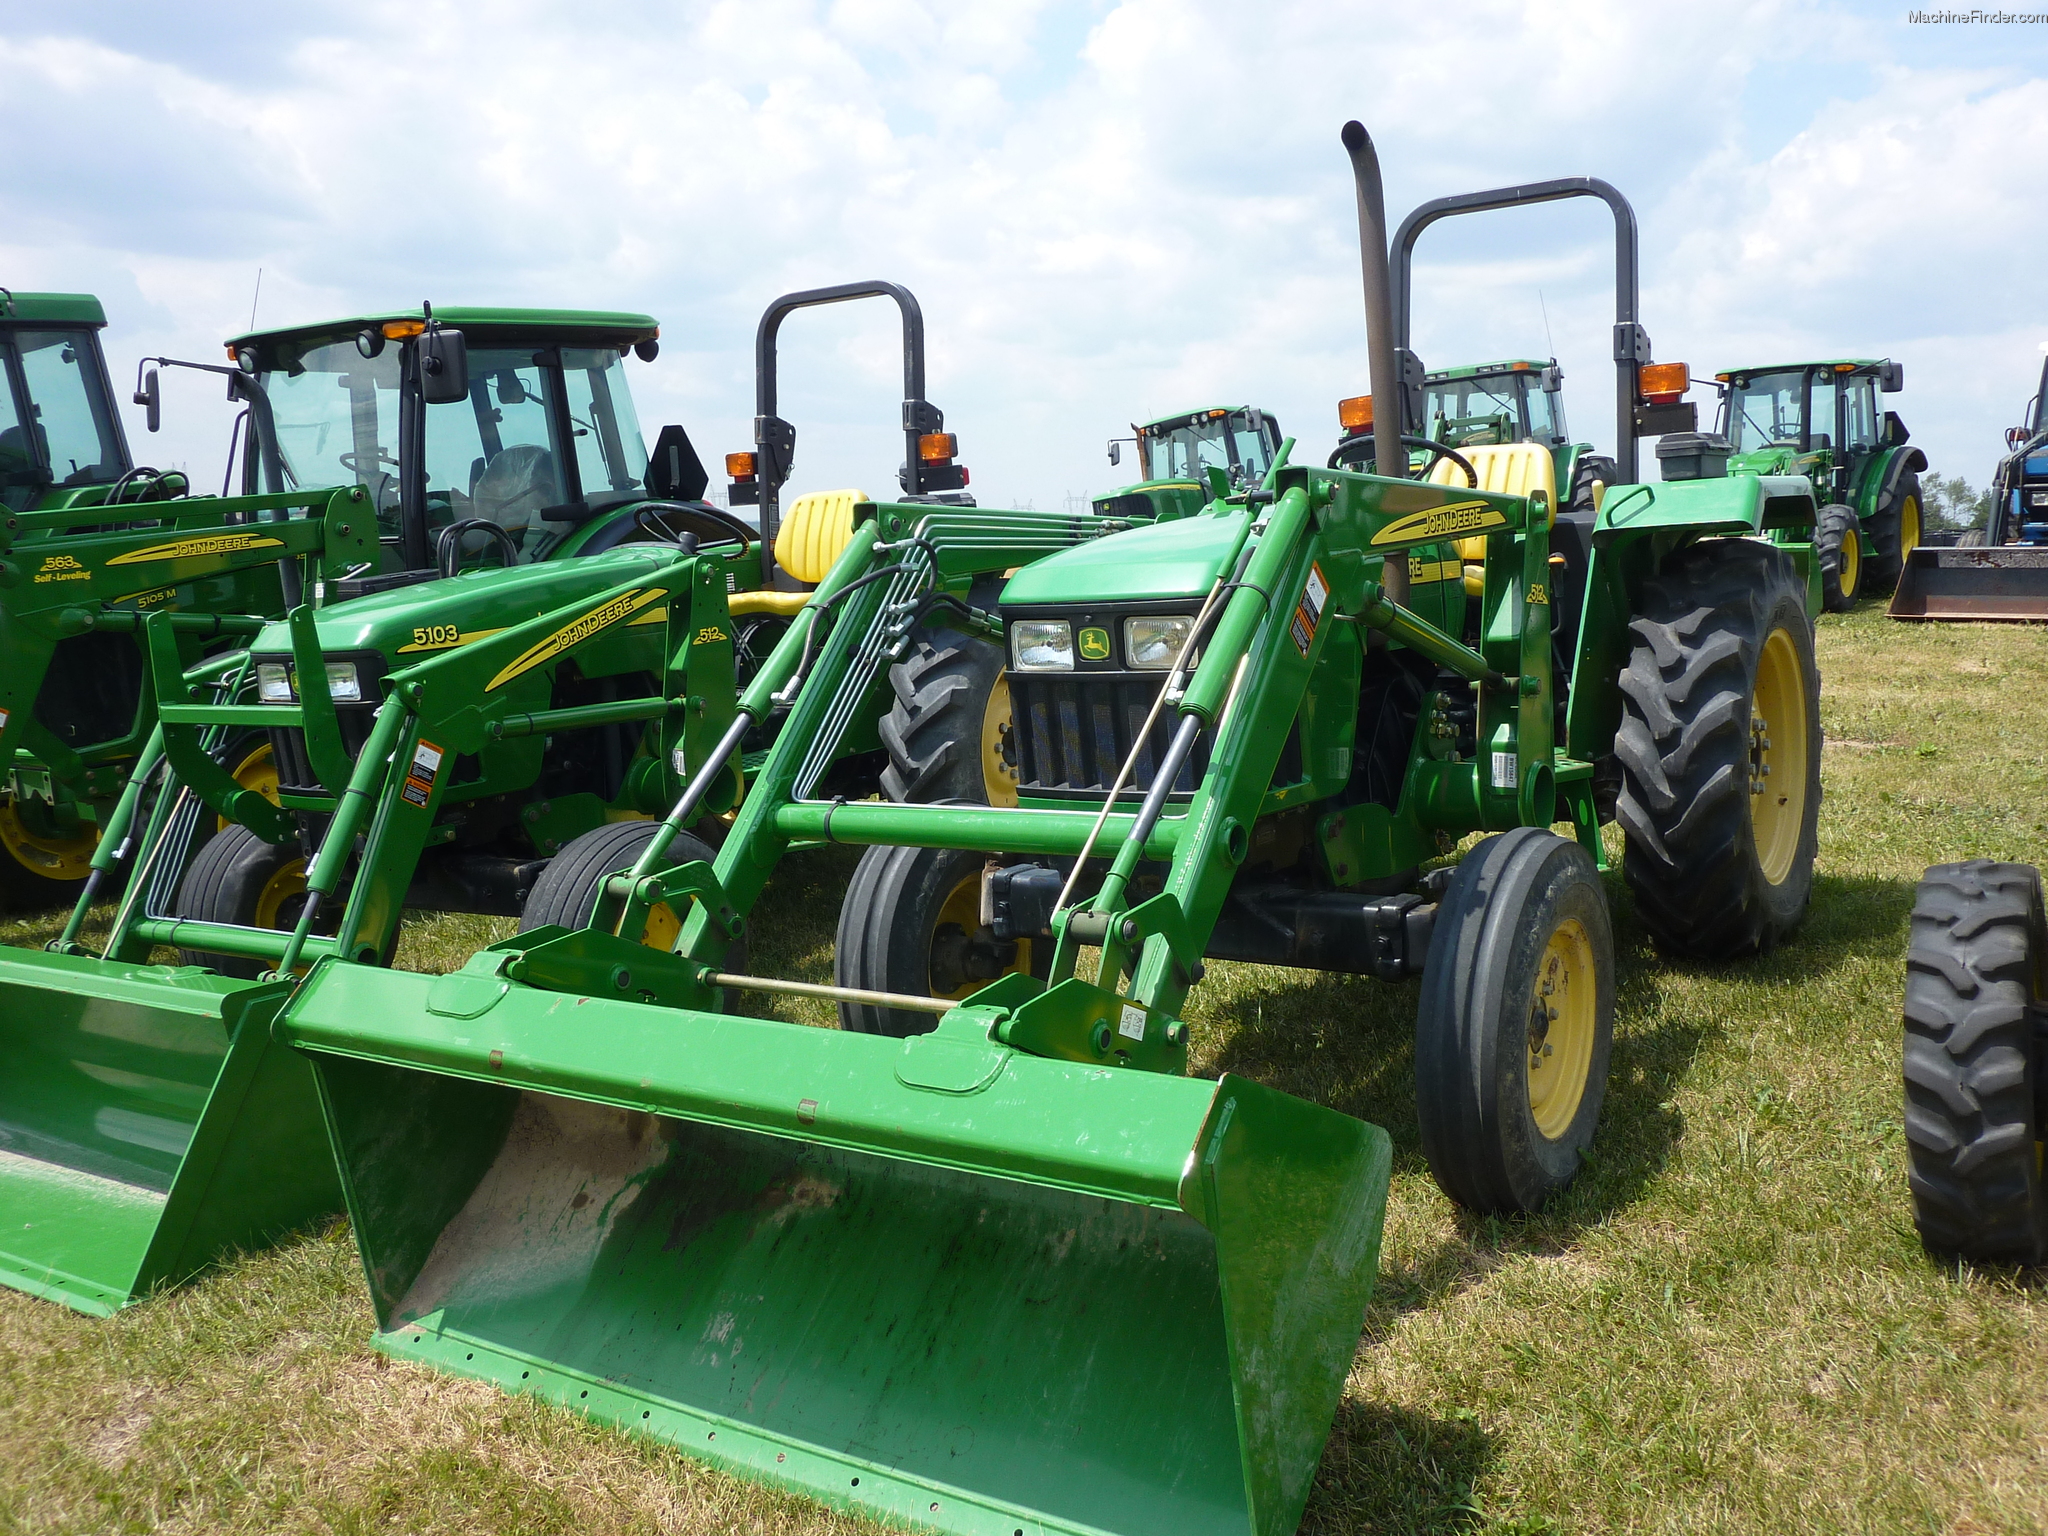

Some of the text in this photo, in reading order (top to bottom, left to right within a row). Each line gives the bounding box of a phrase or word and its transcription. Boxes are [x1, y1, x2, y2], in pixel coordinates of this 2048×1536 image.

[1424, 507, 1482, 535] JOHN DEERE
[173, 537, 250, 556] JOHN DEERE
[45, 555, 74, 569] 563
[138, 588, 177, 608] 5105 M
[1531, 583, 1544, 602] 512
[554, 597, 634, 651] JOHN DEERE
[413, 624, 459, 645] 5103
[700, 626, 719, 642] 512
